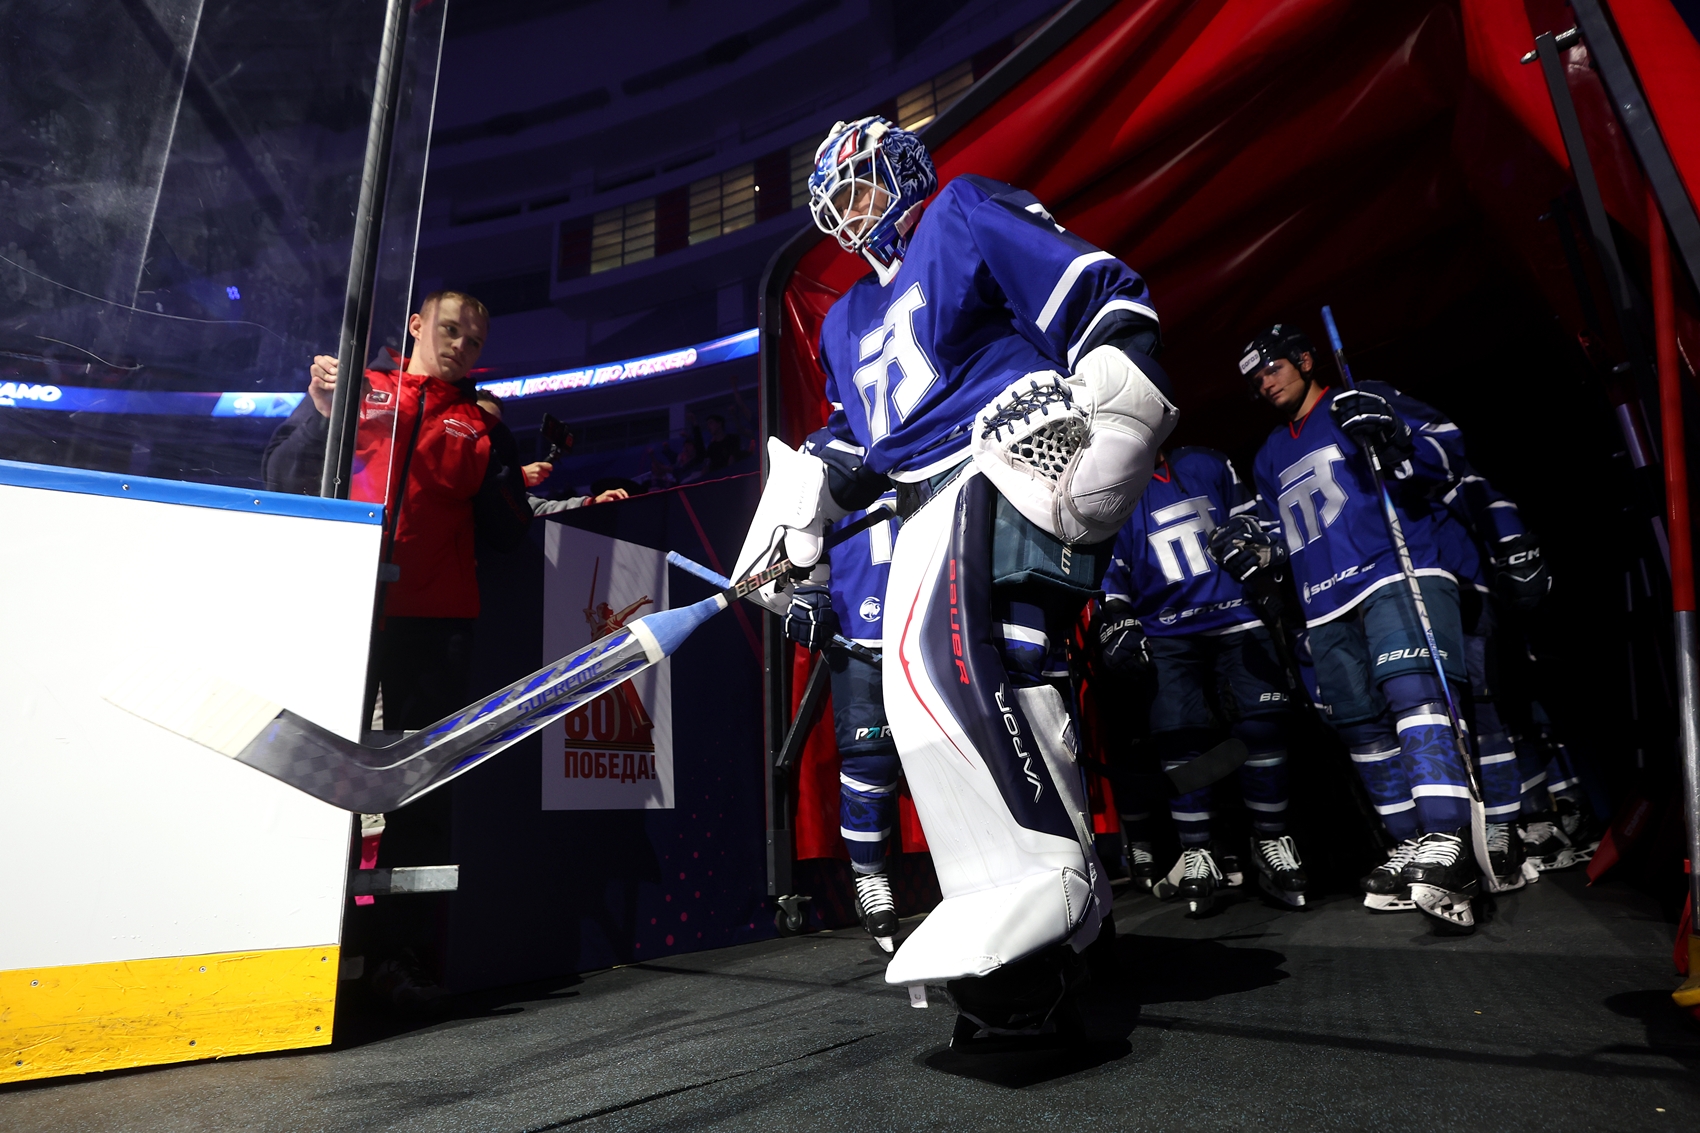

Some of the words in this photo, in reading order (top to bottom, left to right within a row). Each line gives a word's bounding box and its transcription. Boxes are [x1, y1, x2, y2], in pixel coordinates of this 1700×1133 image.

[0, 382, 62, 402] АМО
[1497, 546, 1541, 568] CCM
[735, 558, 794, 598] BAUER
[950, 559, 971, 686] BAUER
[1180, 599, 1243, 619] SOYUZ
[1376, 648, 1448, 667] BAUER
[516, 660, 603, 717] SUPREME
[1259, 692, 1288, 702] BAU
[995, 682, 1044, 803] VAPOR
[564, 751, 656, 784] ПОБЕДА!
